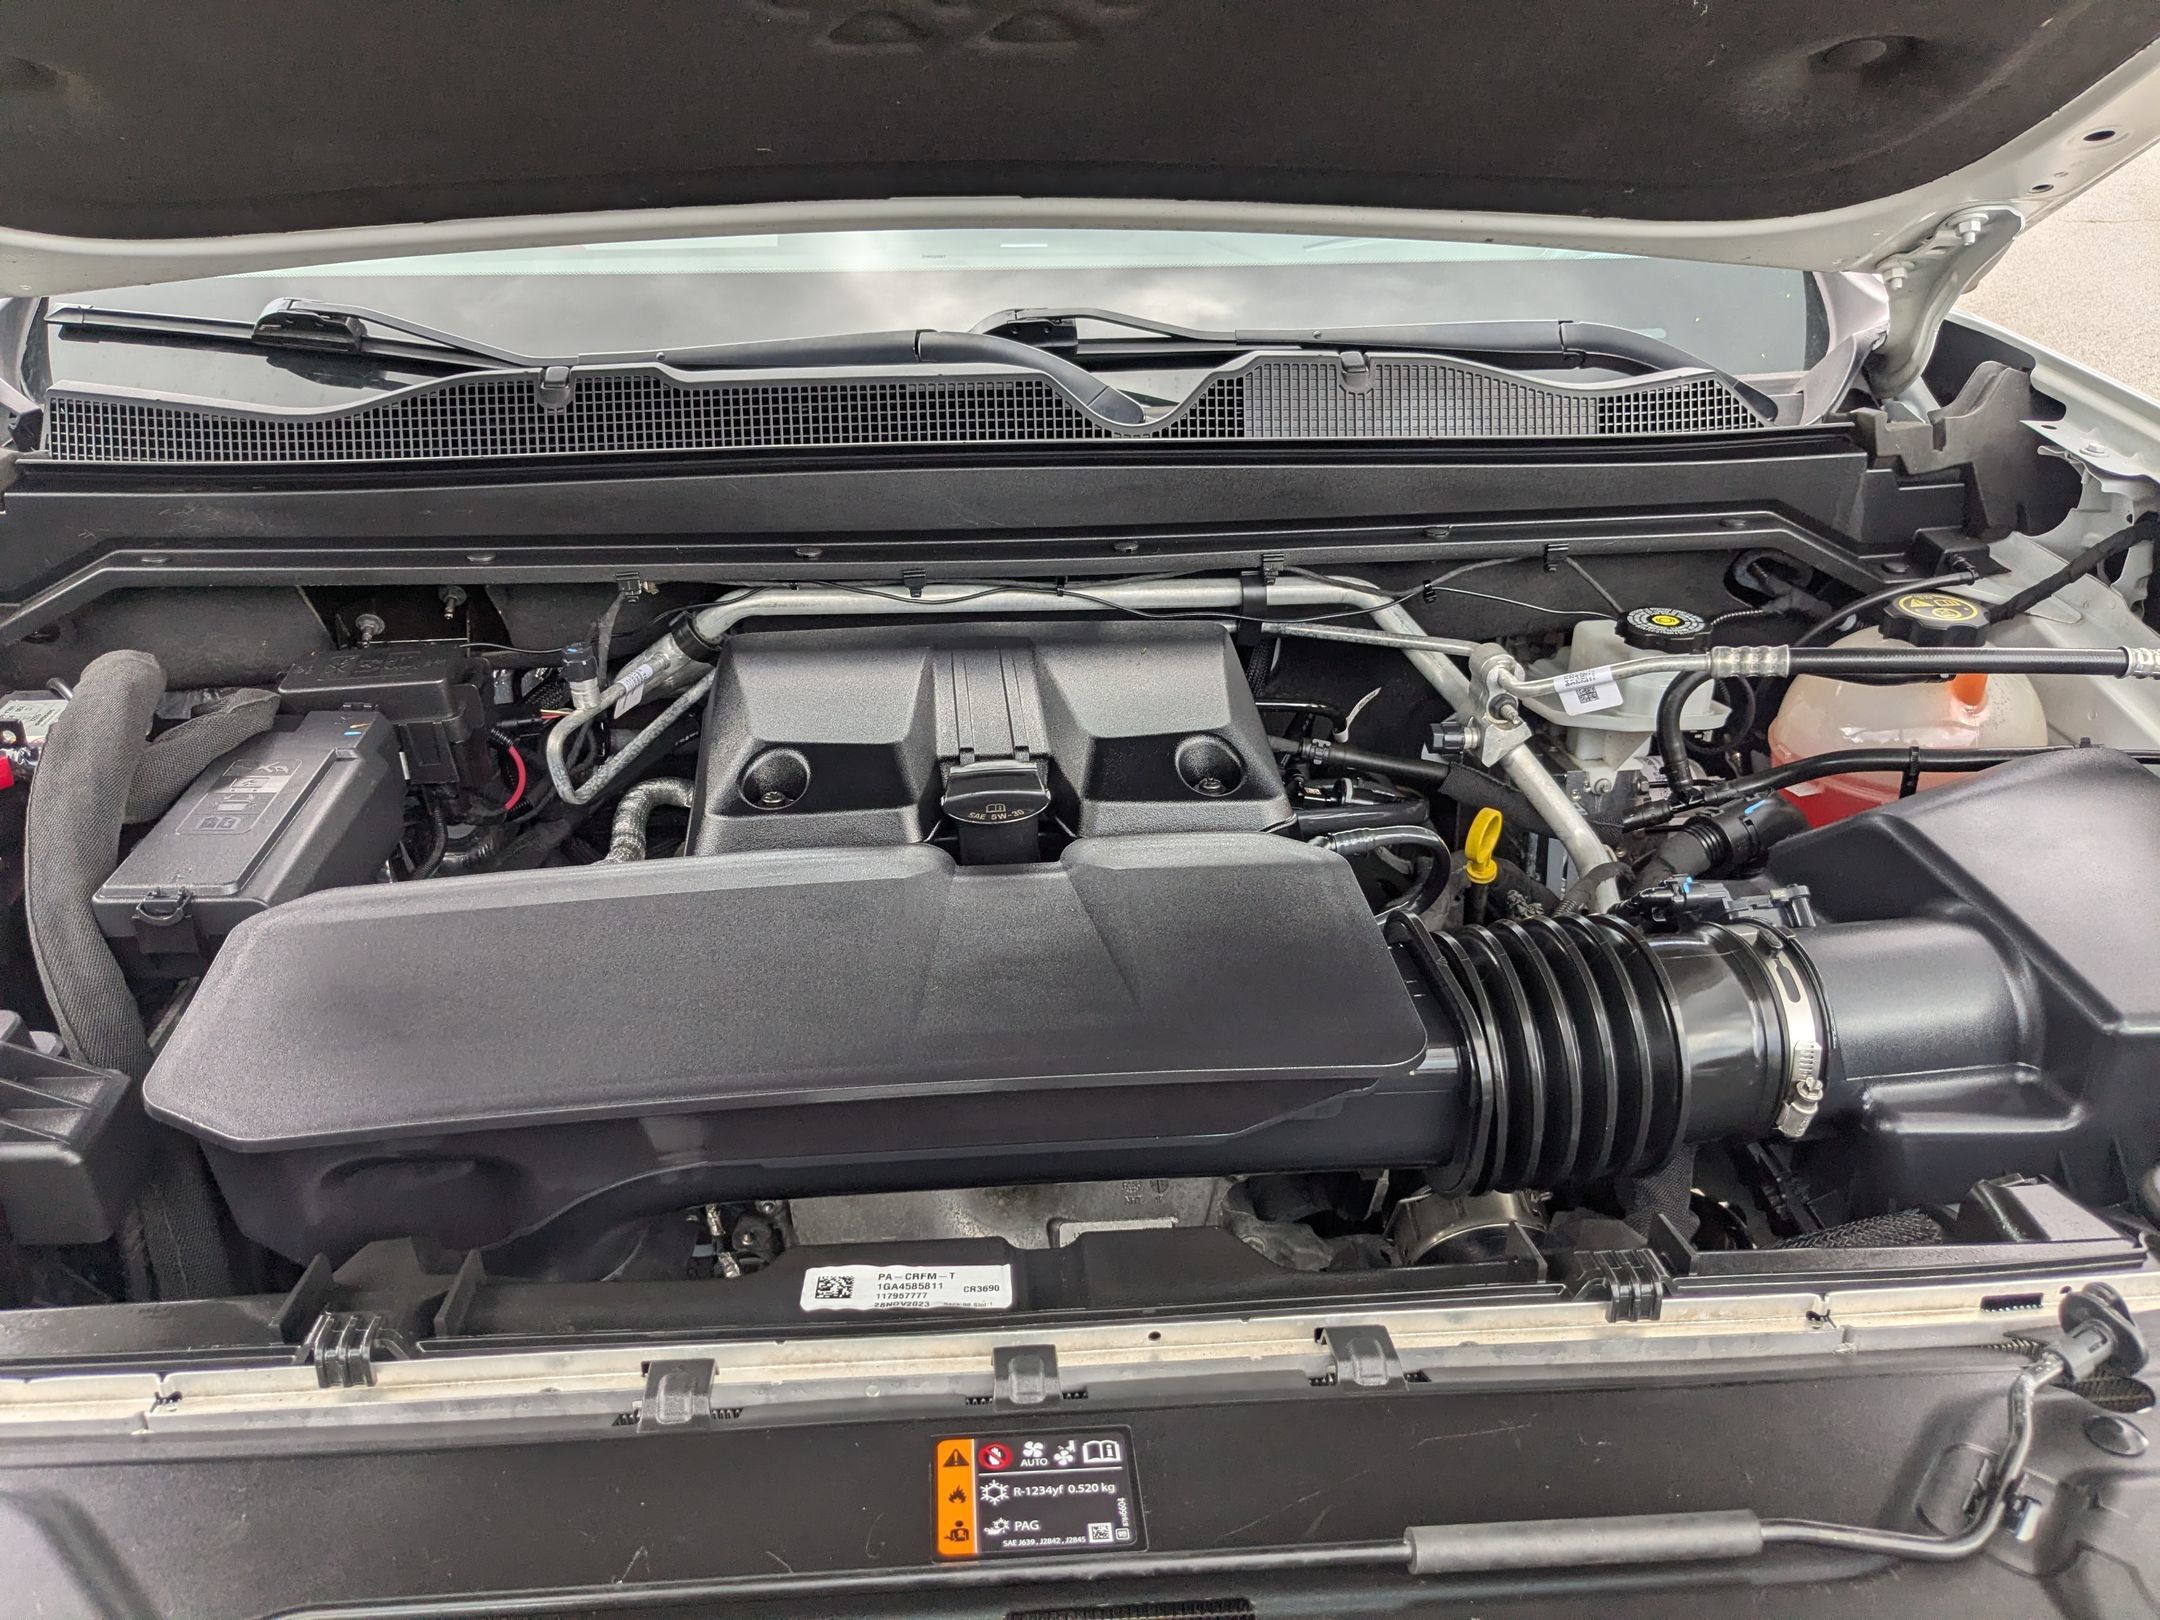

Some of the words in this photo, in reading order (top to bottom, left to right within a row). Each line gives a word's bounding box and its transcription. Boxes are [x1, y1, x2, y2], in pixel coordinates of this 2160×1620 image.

[968, 811, 986, 820] SAE
[990, 809, 1025, 821] 5W-30
[877, 1282, 944, 1291] 1GA4585811
[963, 1285, 1000, 1293] CR3690
[875, 1292, 928, 1300] 117957777
[1020, 1457, 1049, 1468] AUTO
[1013, 1483, 1064, 1498] R-1234yf
[1068, 1482, 1099, 1494] 0.520
[1101, 1481, 1116, 1494] kg
[1014, 1519, 1040, 1531] PAG
[1002, 1539, 1018, 1547] SAE
[1065, 1535, 1087, 1545] J2845
